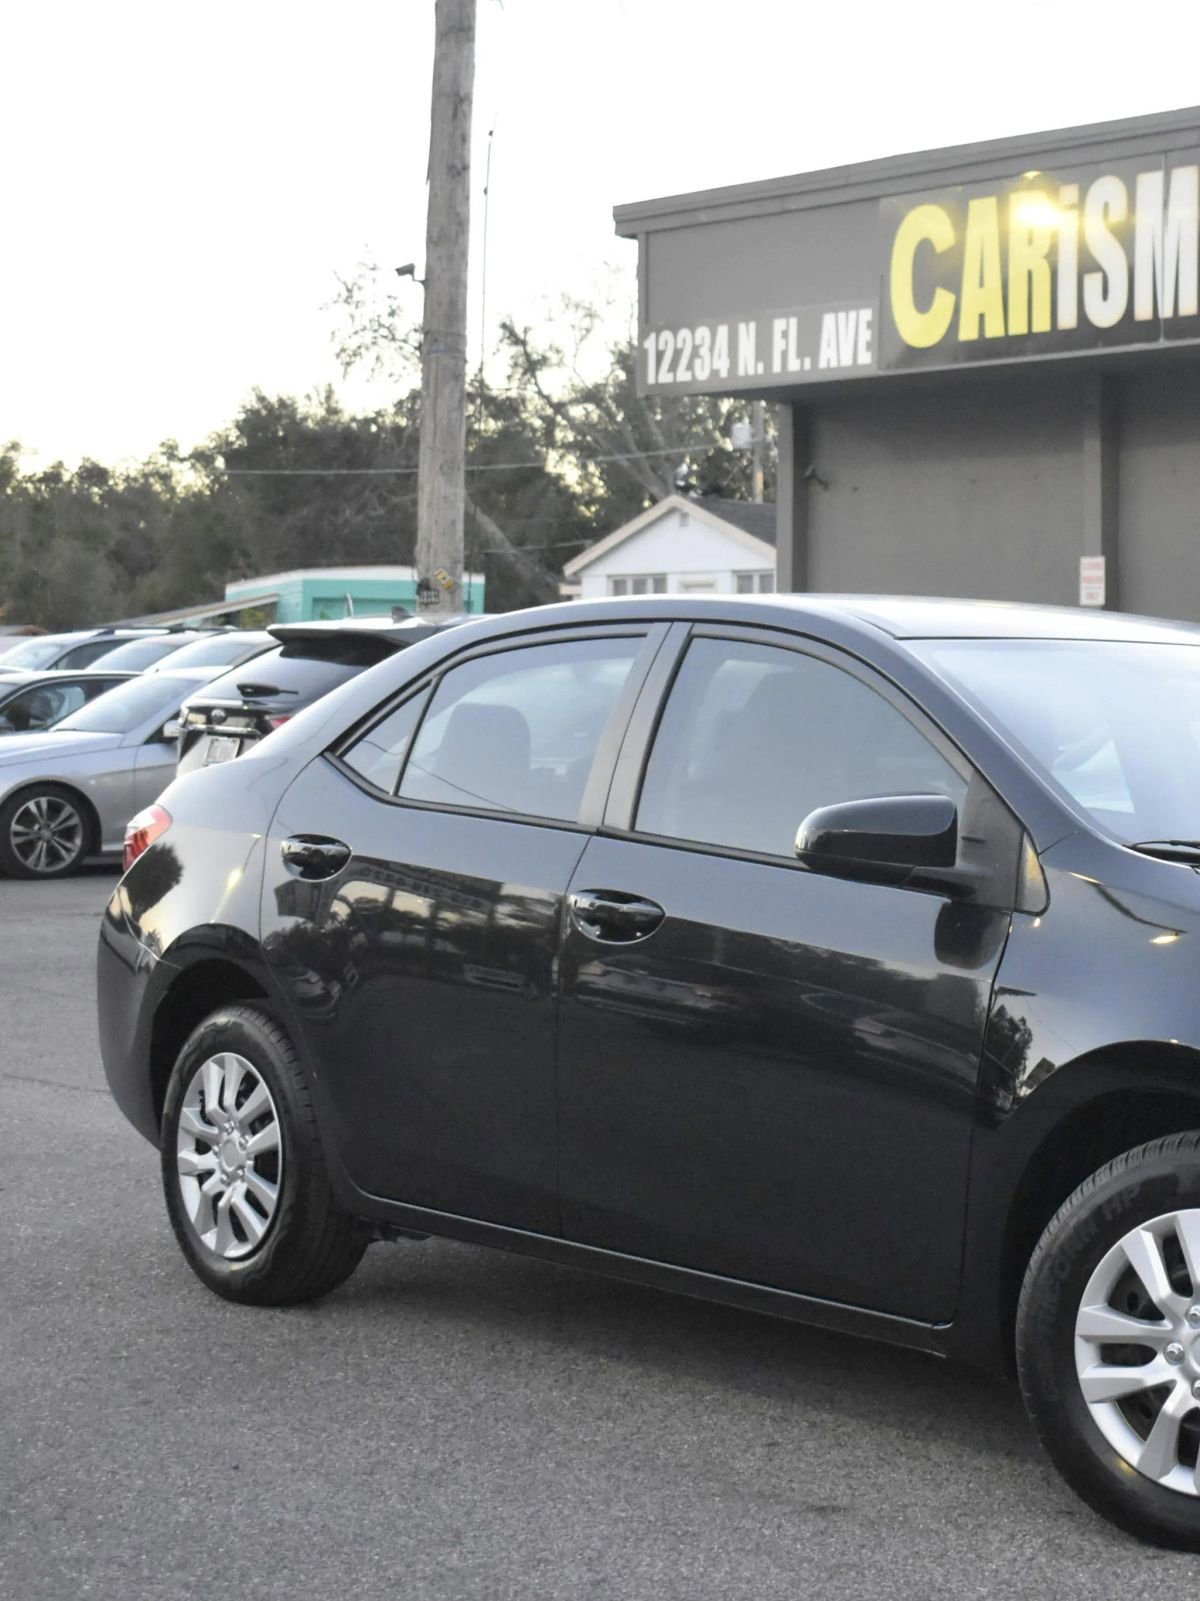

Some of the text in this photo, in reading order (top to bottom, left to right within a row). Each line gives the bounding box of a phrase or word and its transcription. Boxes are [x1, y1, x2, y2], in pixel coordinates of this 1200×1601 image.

[643, 308, 873, 385] 12234 N. FL. AVE
